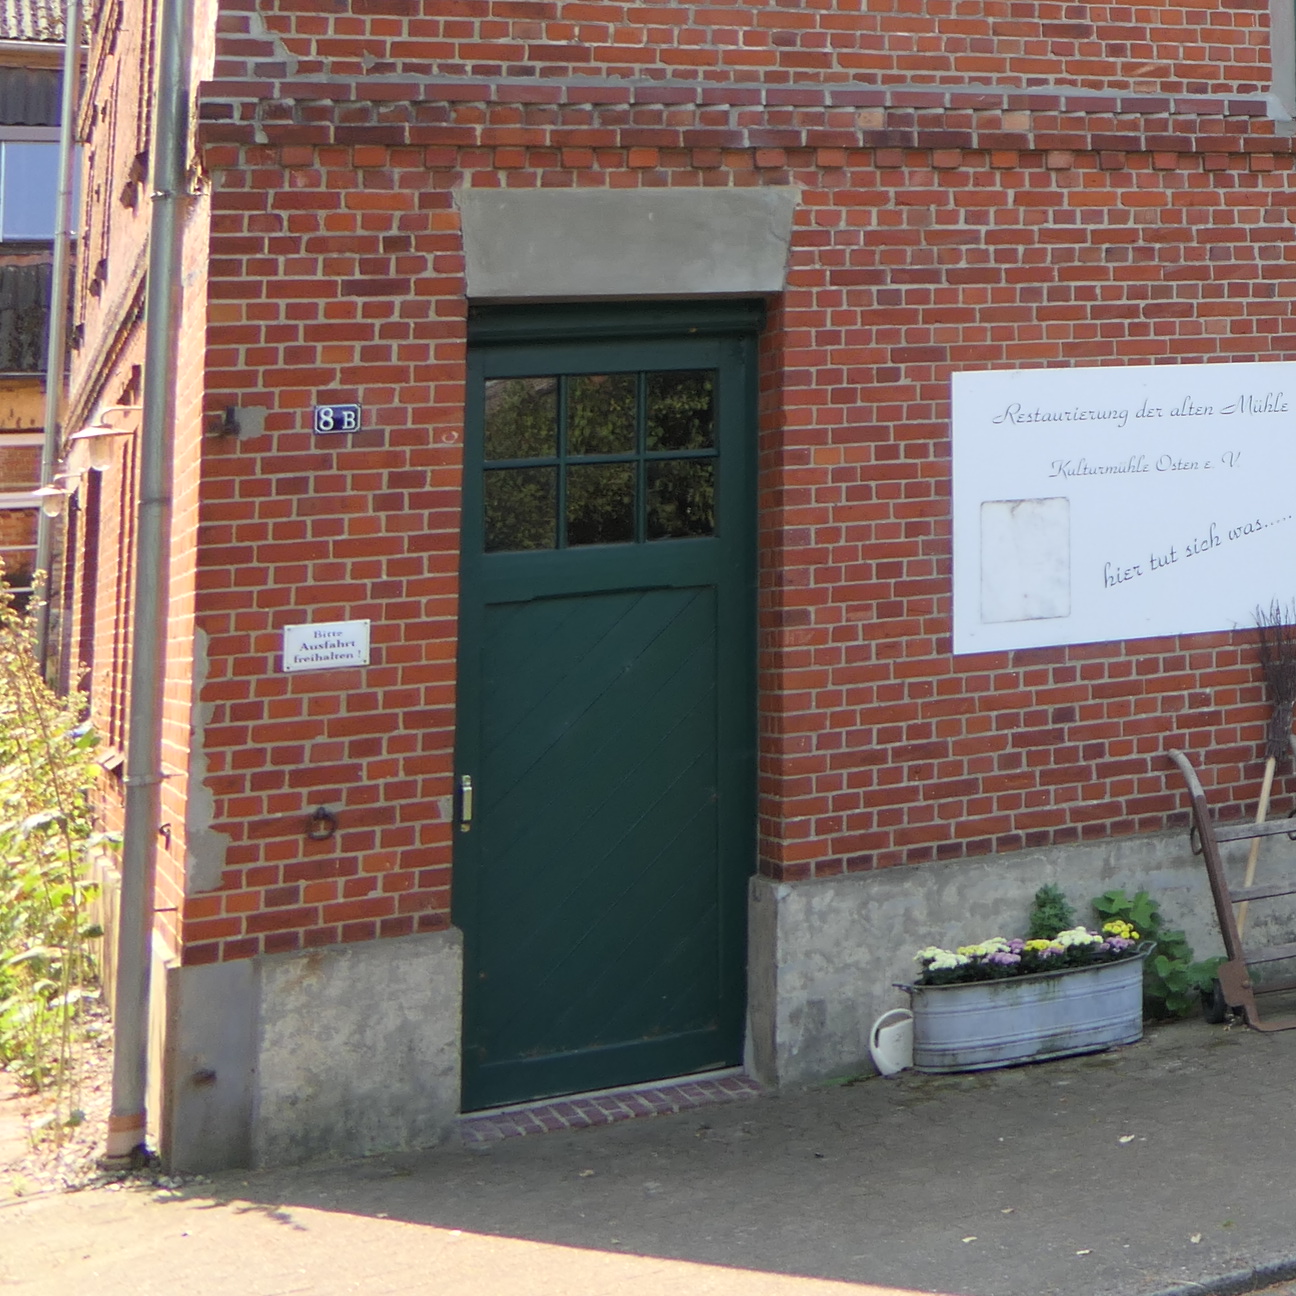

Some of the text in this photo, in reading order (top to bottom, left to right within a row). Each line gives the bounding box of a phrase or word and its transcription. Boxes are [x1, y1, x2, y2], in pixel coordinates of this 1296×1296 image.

[319, 407, 356, 431] 8 B
[992, 391, 1290, 428] Restaurierung der alten Mühle
[1048, 453, 1149, 479] Kulturmühle
[1155, 454, 1199, 473] Osten
[1103, 561, 1143, 589] hier
[1149, 545, 1178, 572] tut
[1185, 521, 1223, 558] sich
[299, 639, 355, 652] Ausfahrt
[313, 629, 343, 639] Bitte
[293, 651, 354, 664] freihalten
